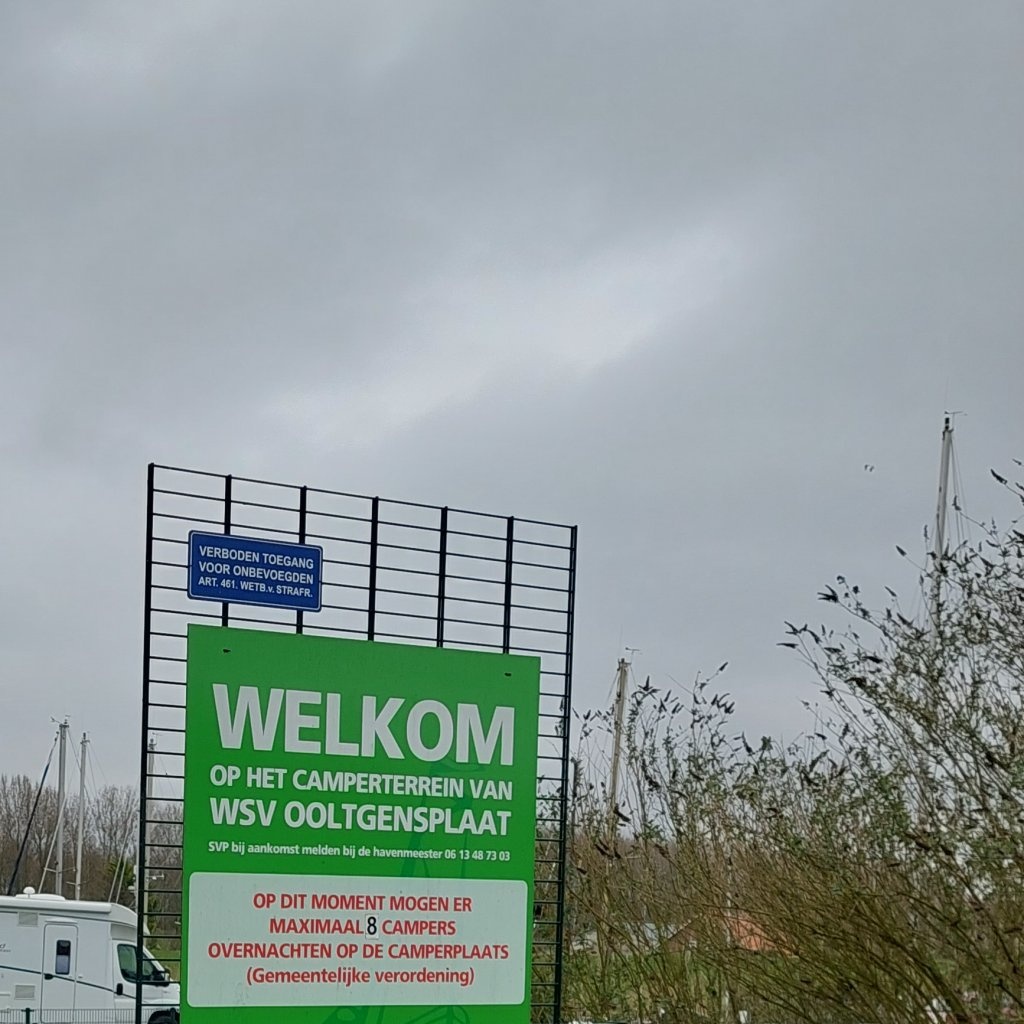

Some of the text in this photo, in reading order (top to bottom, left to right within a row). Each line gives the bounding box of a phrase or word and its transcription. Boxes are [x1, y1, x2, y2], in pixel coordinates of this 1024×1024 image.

[199, 545, 314, 569] VERBODEN TOEGANG
[198, 561, 314, 584] VOOR ONBEVOEGDEN
[198, 576, 218, 587] ART.
[220, 579, 238, 589] 461.
[276, 585, 313, 597] STRAFR.
[212, 683, 515, 766] WELKOM
[210, 764, 512, 800] OP HET CAMPERTERREIN VAN
[210, 797, 512, 836] WSV OOLTGENSPLAAT
[208, 841, 510, 861] SVP bij aankomst melden bij de havenmeester 06 13 48 73 03
[253, 893, 472, 912] OP DIT MOMENT MOGEN ER
[270, 916, 456, 935] MAXIMAAL 8 CAMPERS
[208, 942, 509, 959] OVERNACHTEN OP DE CAMPERPLAATS
[246, 966, 474, 987] (Gemeentelijke verordening)
